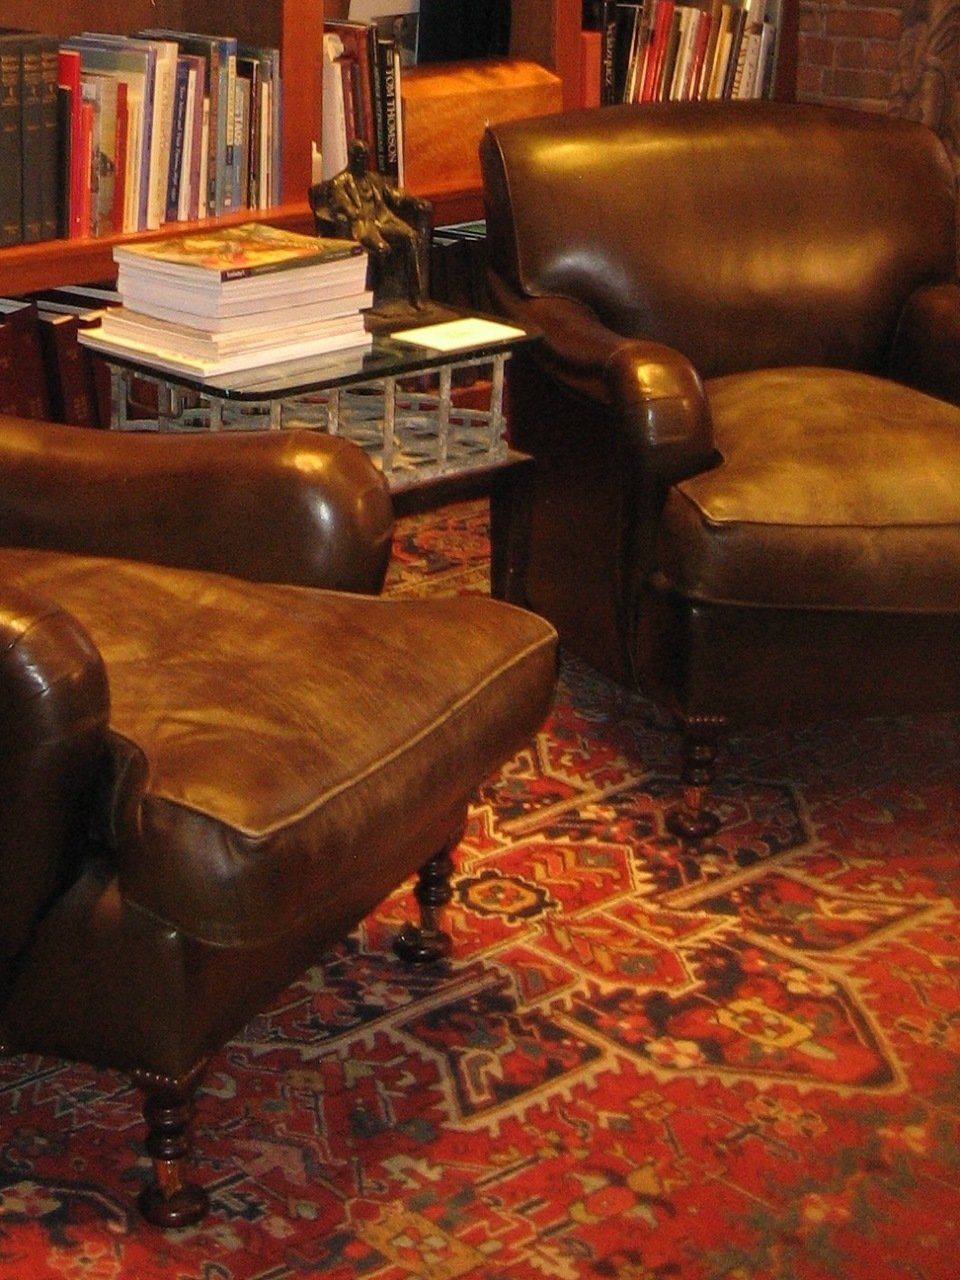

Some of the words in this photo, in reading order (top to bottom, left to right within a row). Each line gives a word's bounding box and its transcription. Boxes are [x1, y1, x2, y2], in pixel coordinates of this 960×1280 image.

[385, 69, 395, 97] TOM
[234, 116, 244, 146] TAOS
[386, 101, 397, 163] THOMSON
